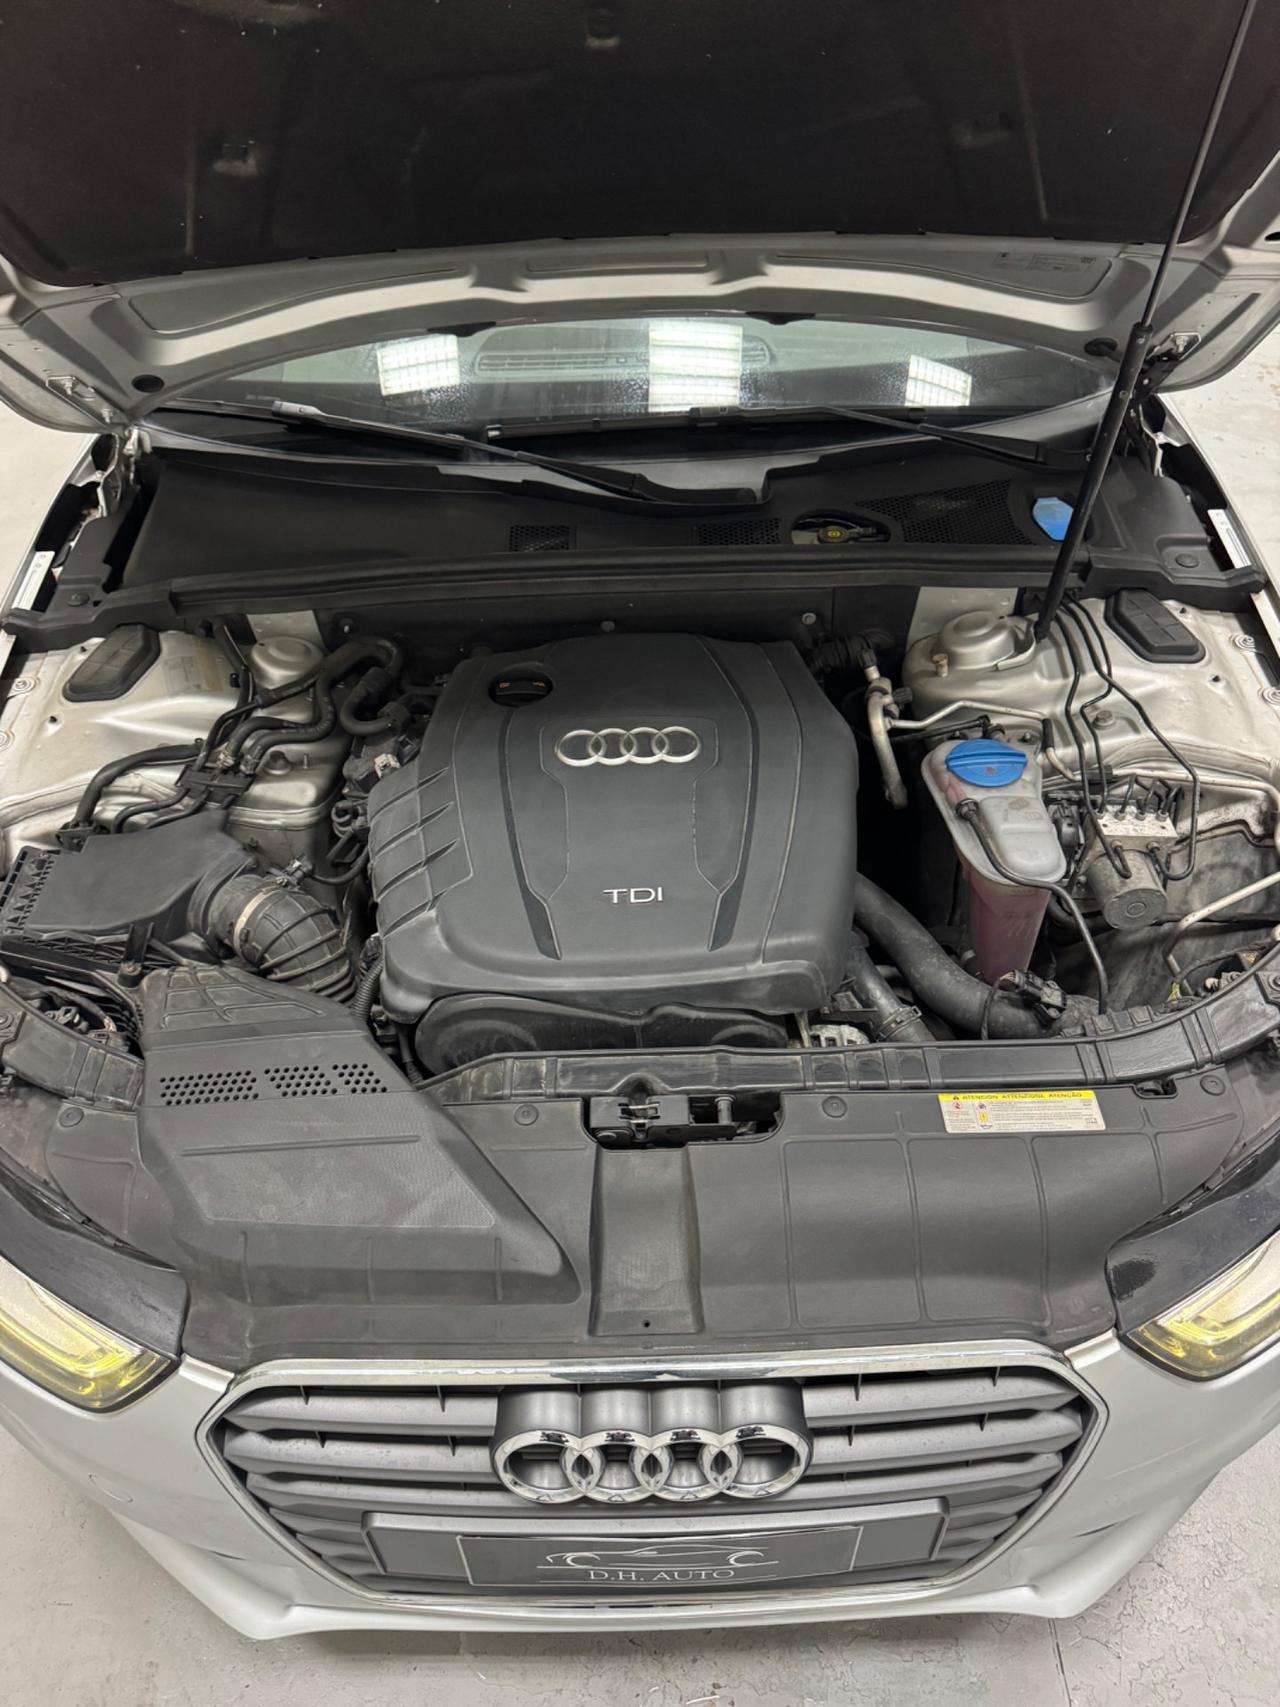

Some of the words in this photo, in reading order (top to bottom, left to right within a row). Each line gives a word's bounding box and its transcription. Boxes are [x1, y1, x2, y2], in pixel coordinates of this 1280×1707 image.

[603, 887, 663, 904] TDI
[588, 1570, 644, 1581] D.H.
[652, 1569, 735, 1581] AUTO
